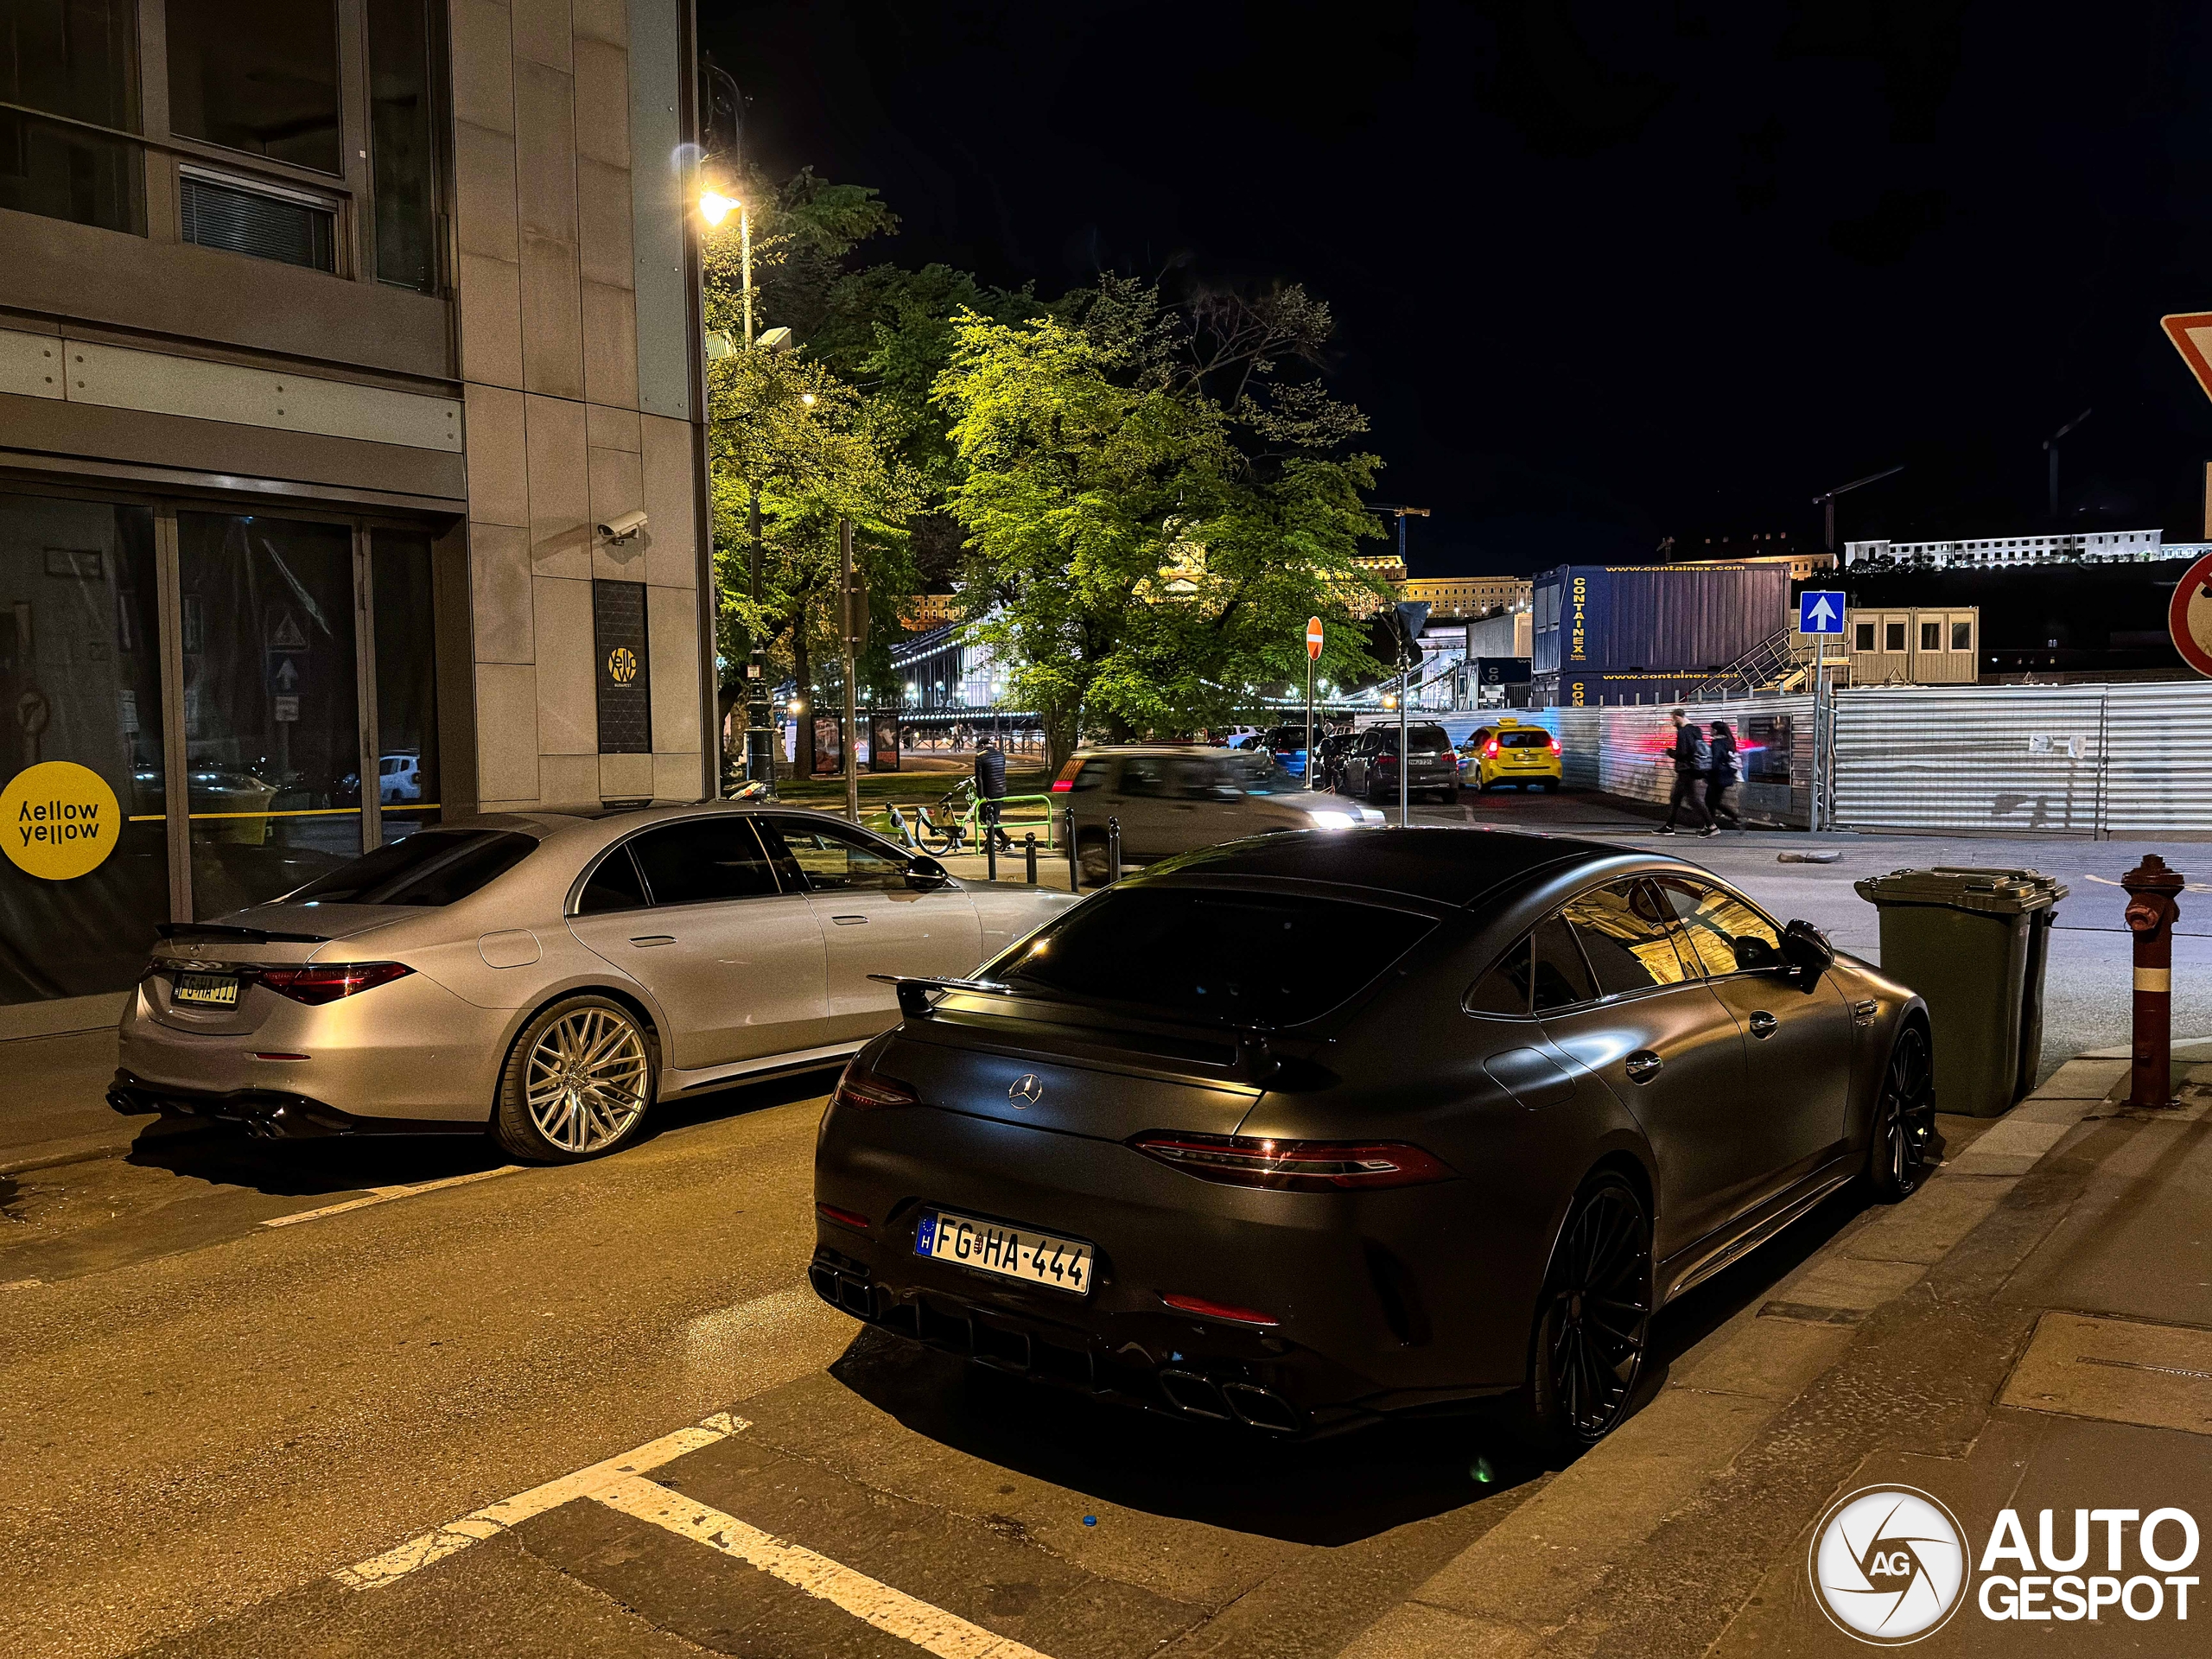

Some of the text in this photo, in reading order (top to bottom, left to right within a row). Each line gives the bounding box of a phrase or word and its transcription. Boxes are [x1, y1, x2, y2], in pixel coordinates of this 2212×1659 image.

[1573, 577, 1586, 653] CONTAINEX
[19, 823, 99, 847] yellow
[921, 1235, 931, 1249] H
